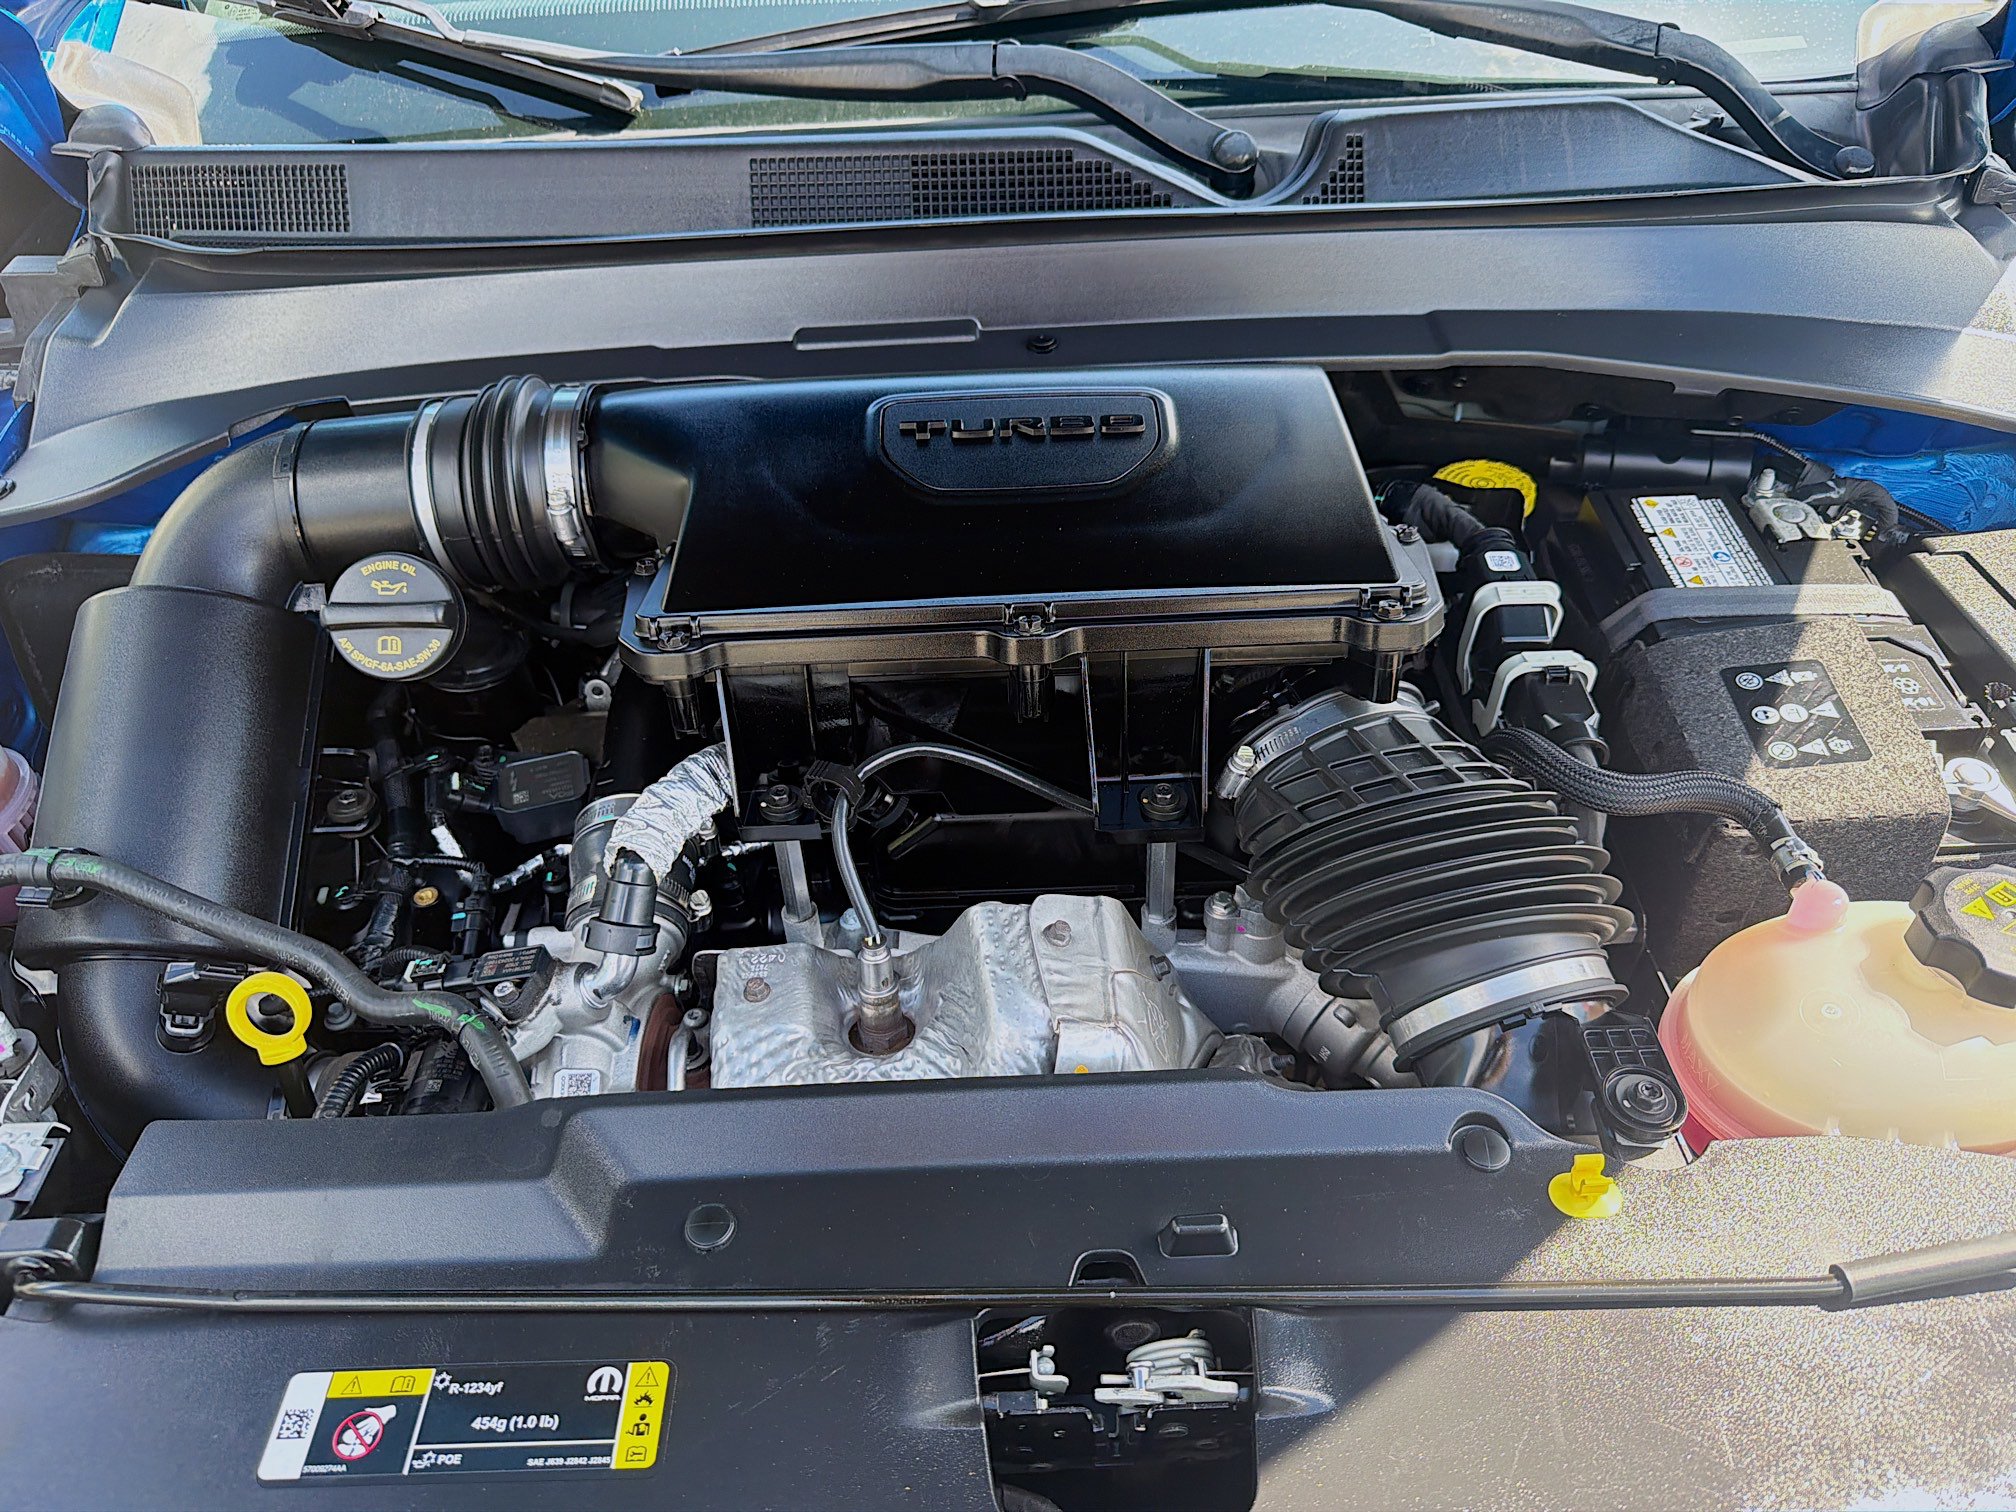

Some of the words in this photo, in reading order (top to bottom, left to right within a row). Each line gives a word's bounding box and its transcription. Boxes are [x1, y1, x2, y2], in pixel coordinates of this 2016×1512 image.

[899, 414, 1146, 441] TURBO
[360, 560, 400, 577] ENGINE
[400, 562, 417, 577] OIL
[338, 637, 354, 654] API
[448, 1381, 505, 1396] R-1234yf
[470, 1416, 508, 1433] 454g
[508, 1414, 538, 1432] (1.0
[538, 1414, 560, 1431] lb)
[436, 1453, 463, 1466] POE
[526, 1457, 545, 1467] SAE
